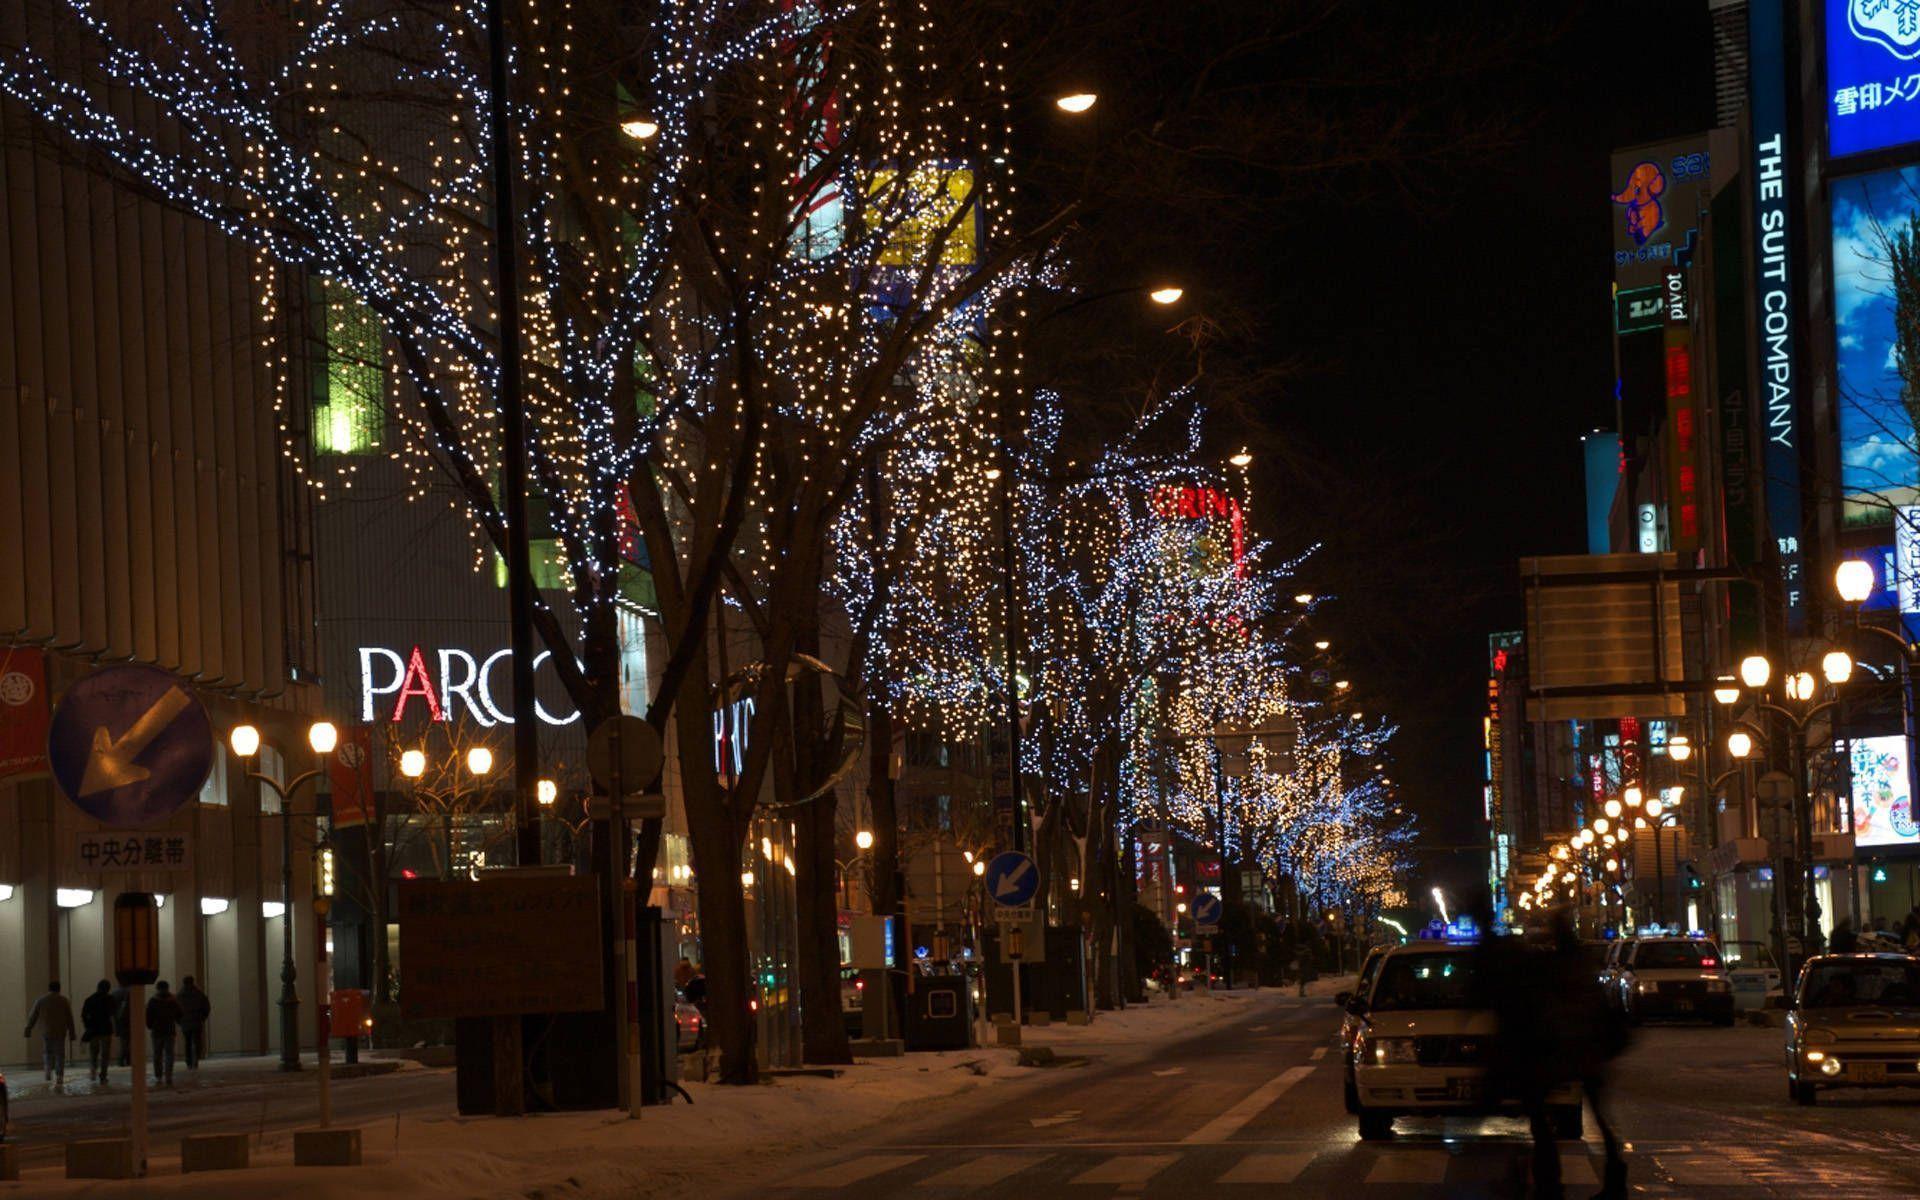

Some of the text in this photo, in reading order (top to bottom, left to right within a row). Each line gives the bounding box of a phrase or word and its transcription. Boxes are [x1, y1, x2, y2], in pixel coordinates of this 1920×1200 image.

[1665, 272, 1689, 321] pivot
[1759, 133, 1794, 449] THE SUIT COMPANY
[358, 645, 584, 728] PARCO
[80, 837, 186, 867] 中央分離帯
